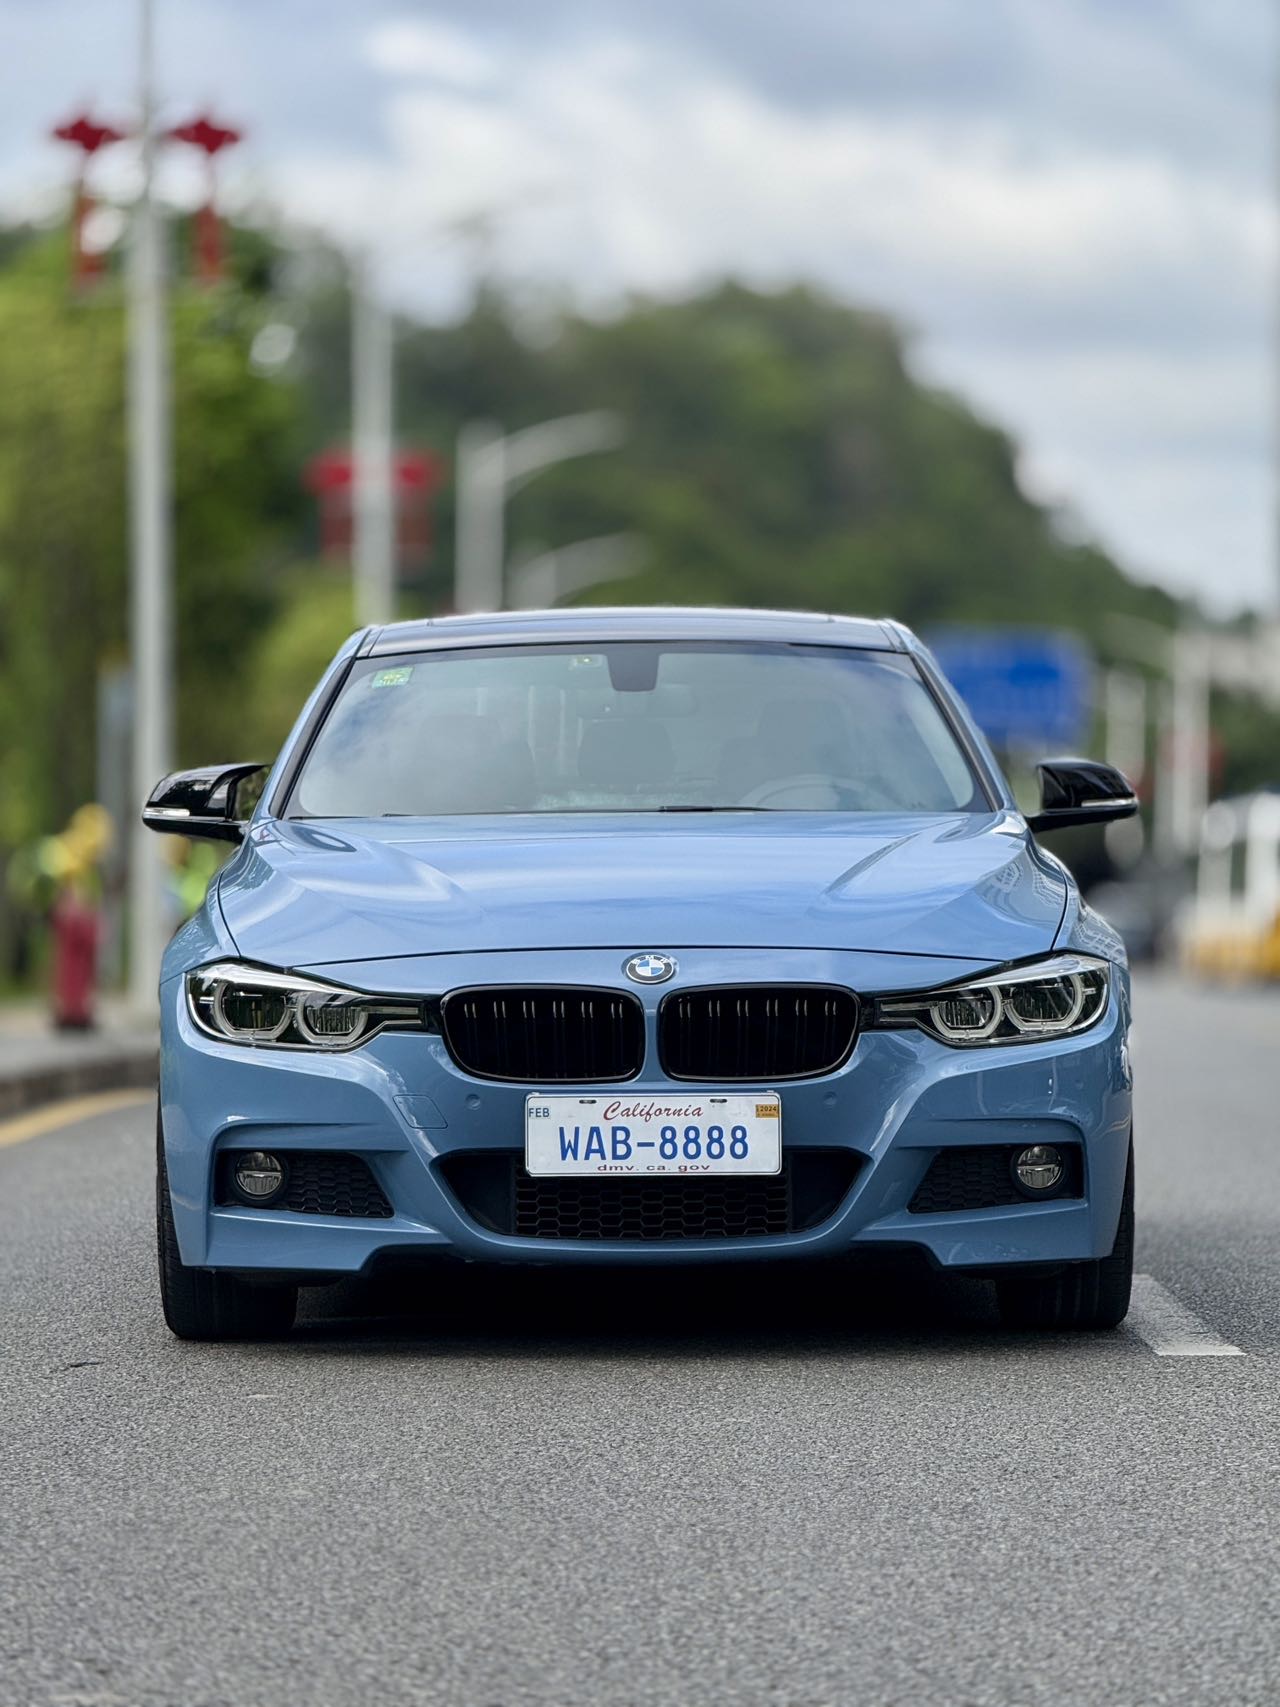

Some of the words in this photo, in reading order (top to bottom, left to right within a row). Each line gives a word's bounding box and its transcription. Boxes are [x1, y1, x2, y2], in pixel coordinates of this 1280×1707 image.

[528, 1107, 550, 1118] FEB
[603, 1101, 703, 1122] California
[559, 1125, 749, 1161] WAB-8888
